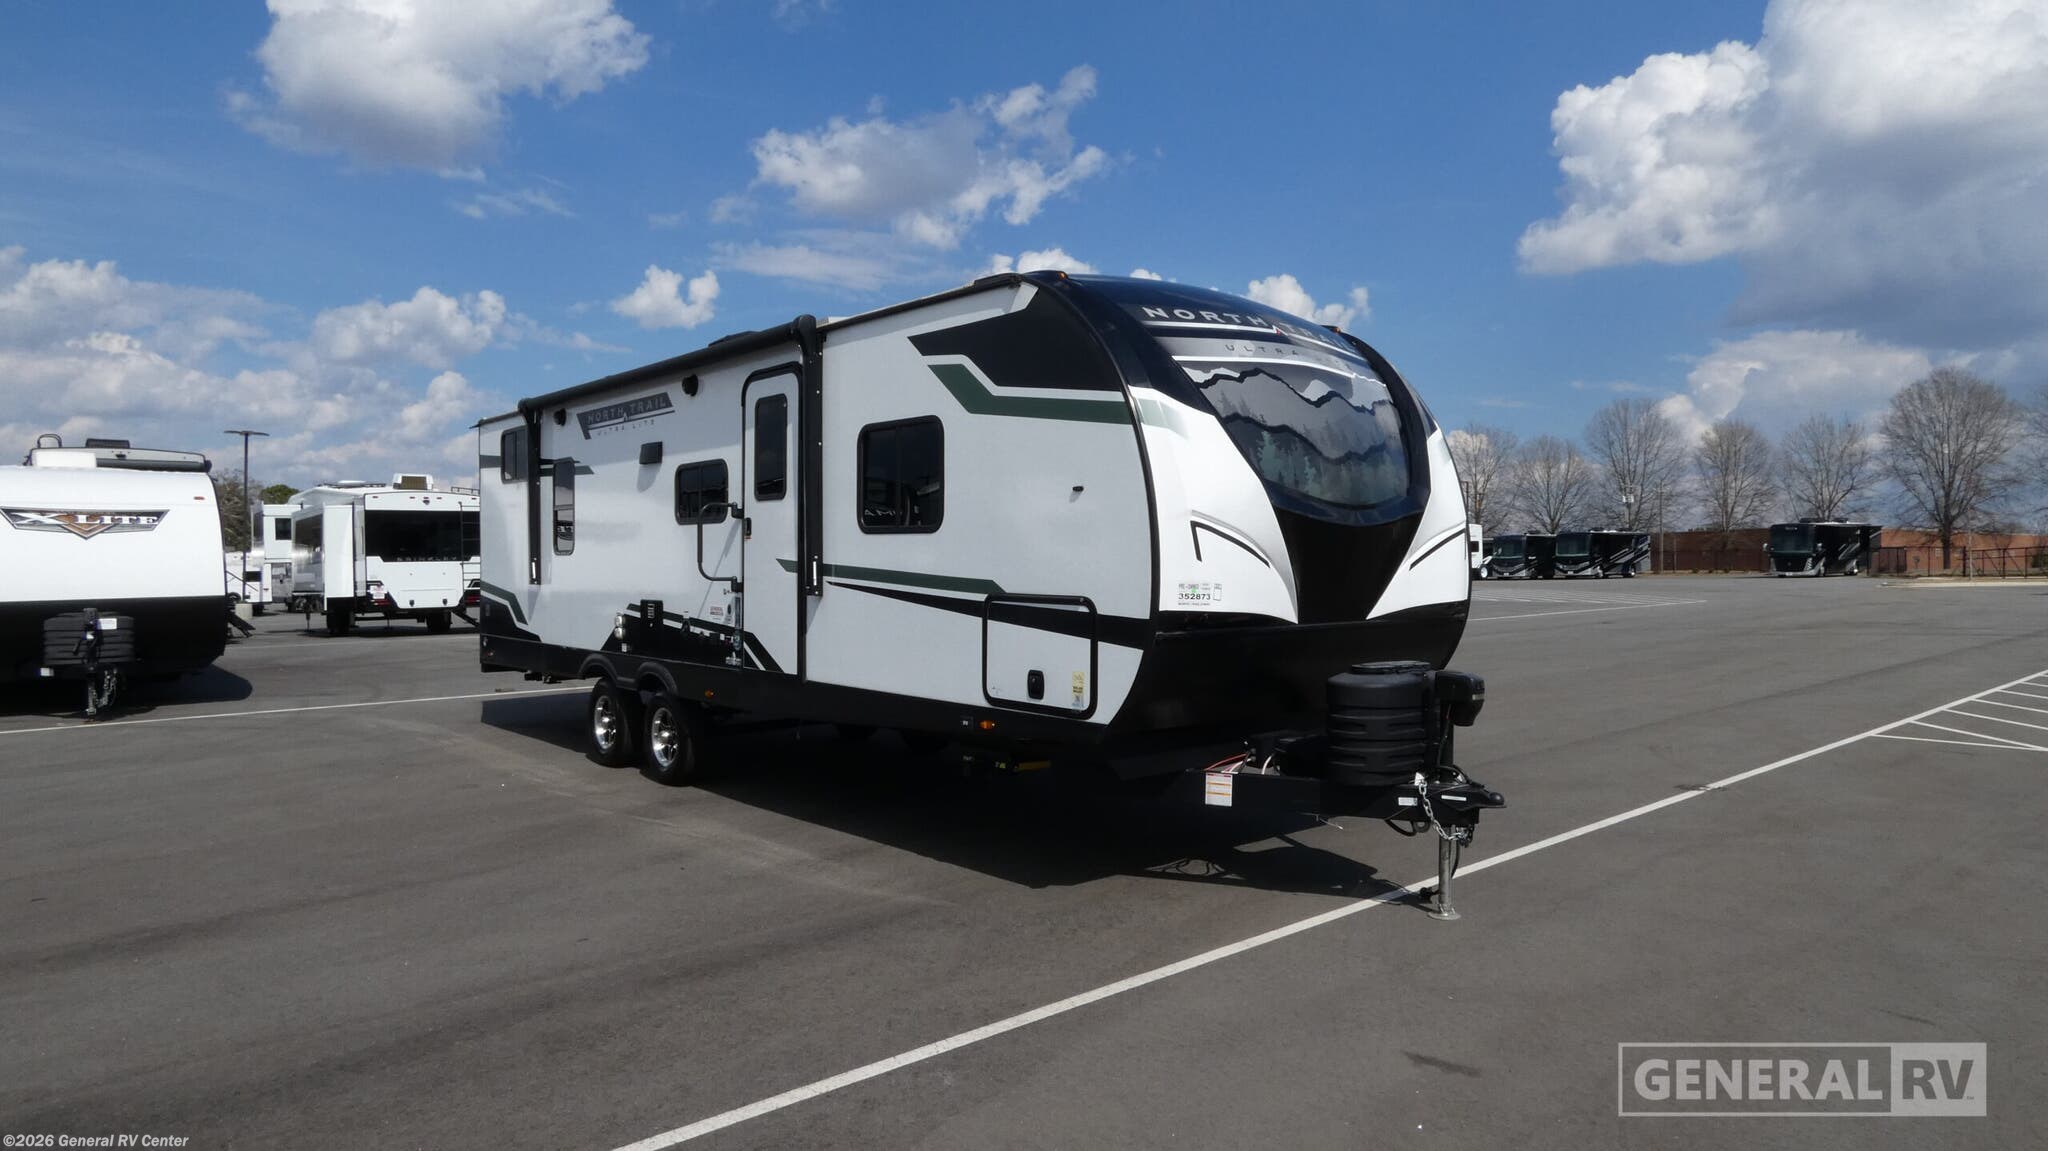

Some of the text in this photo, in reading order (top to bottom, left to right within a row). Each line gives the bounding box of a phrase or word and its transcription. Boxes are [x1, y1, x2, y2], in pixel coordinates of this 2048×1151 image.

[1142, 305, 1269, 327] NORTH
[1225, 344, 1299, 356] ULTRA
[587, 396, 667, 424] NORTH TRAIL
